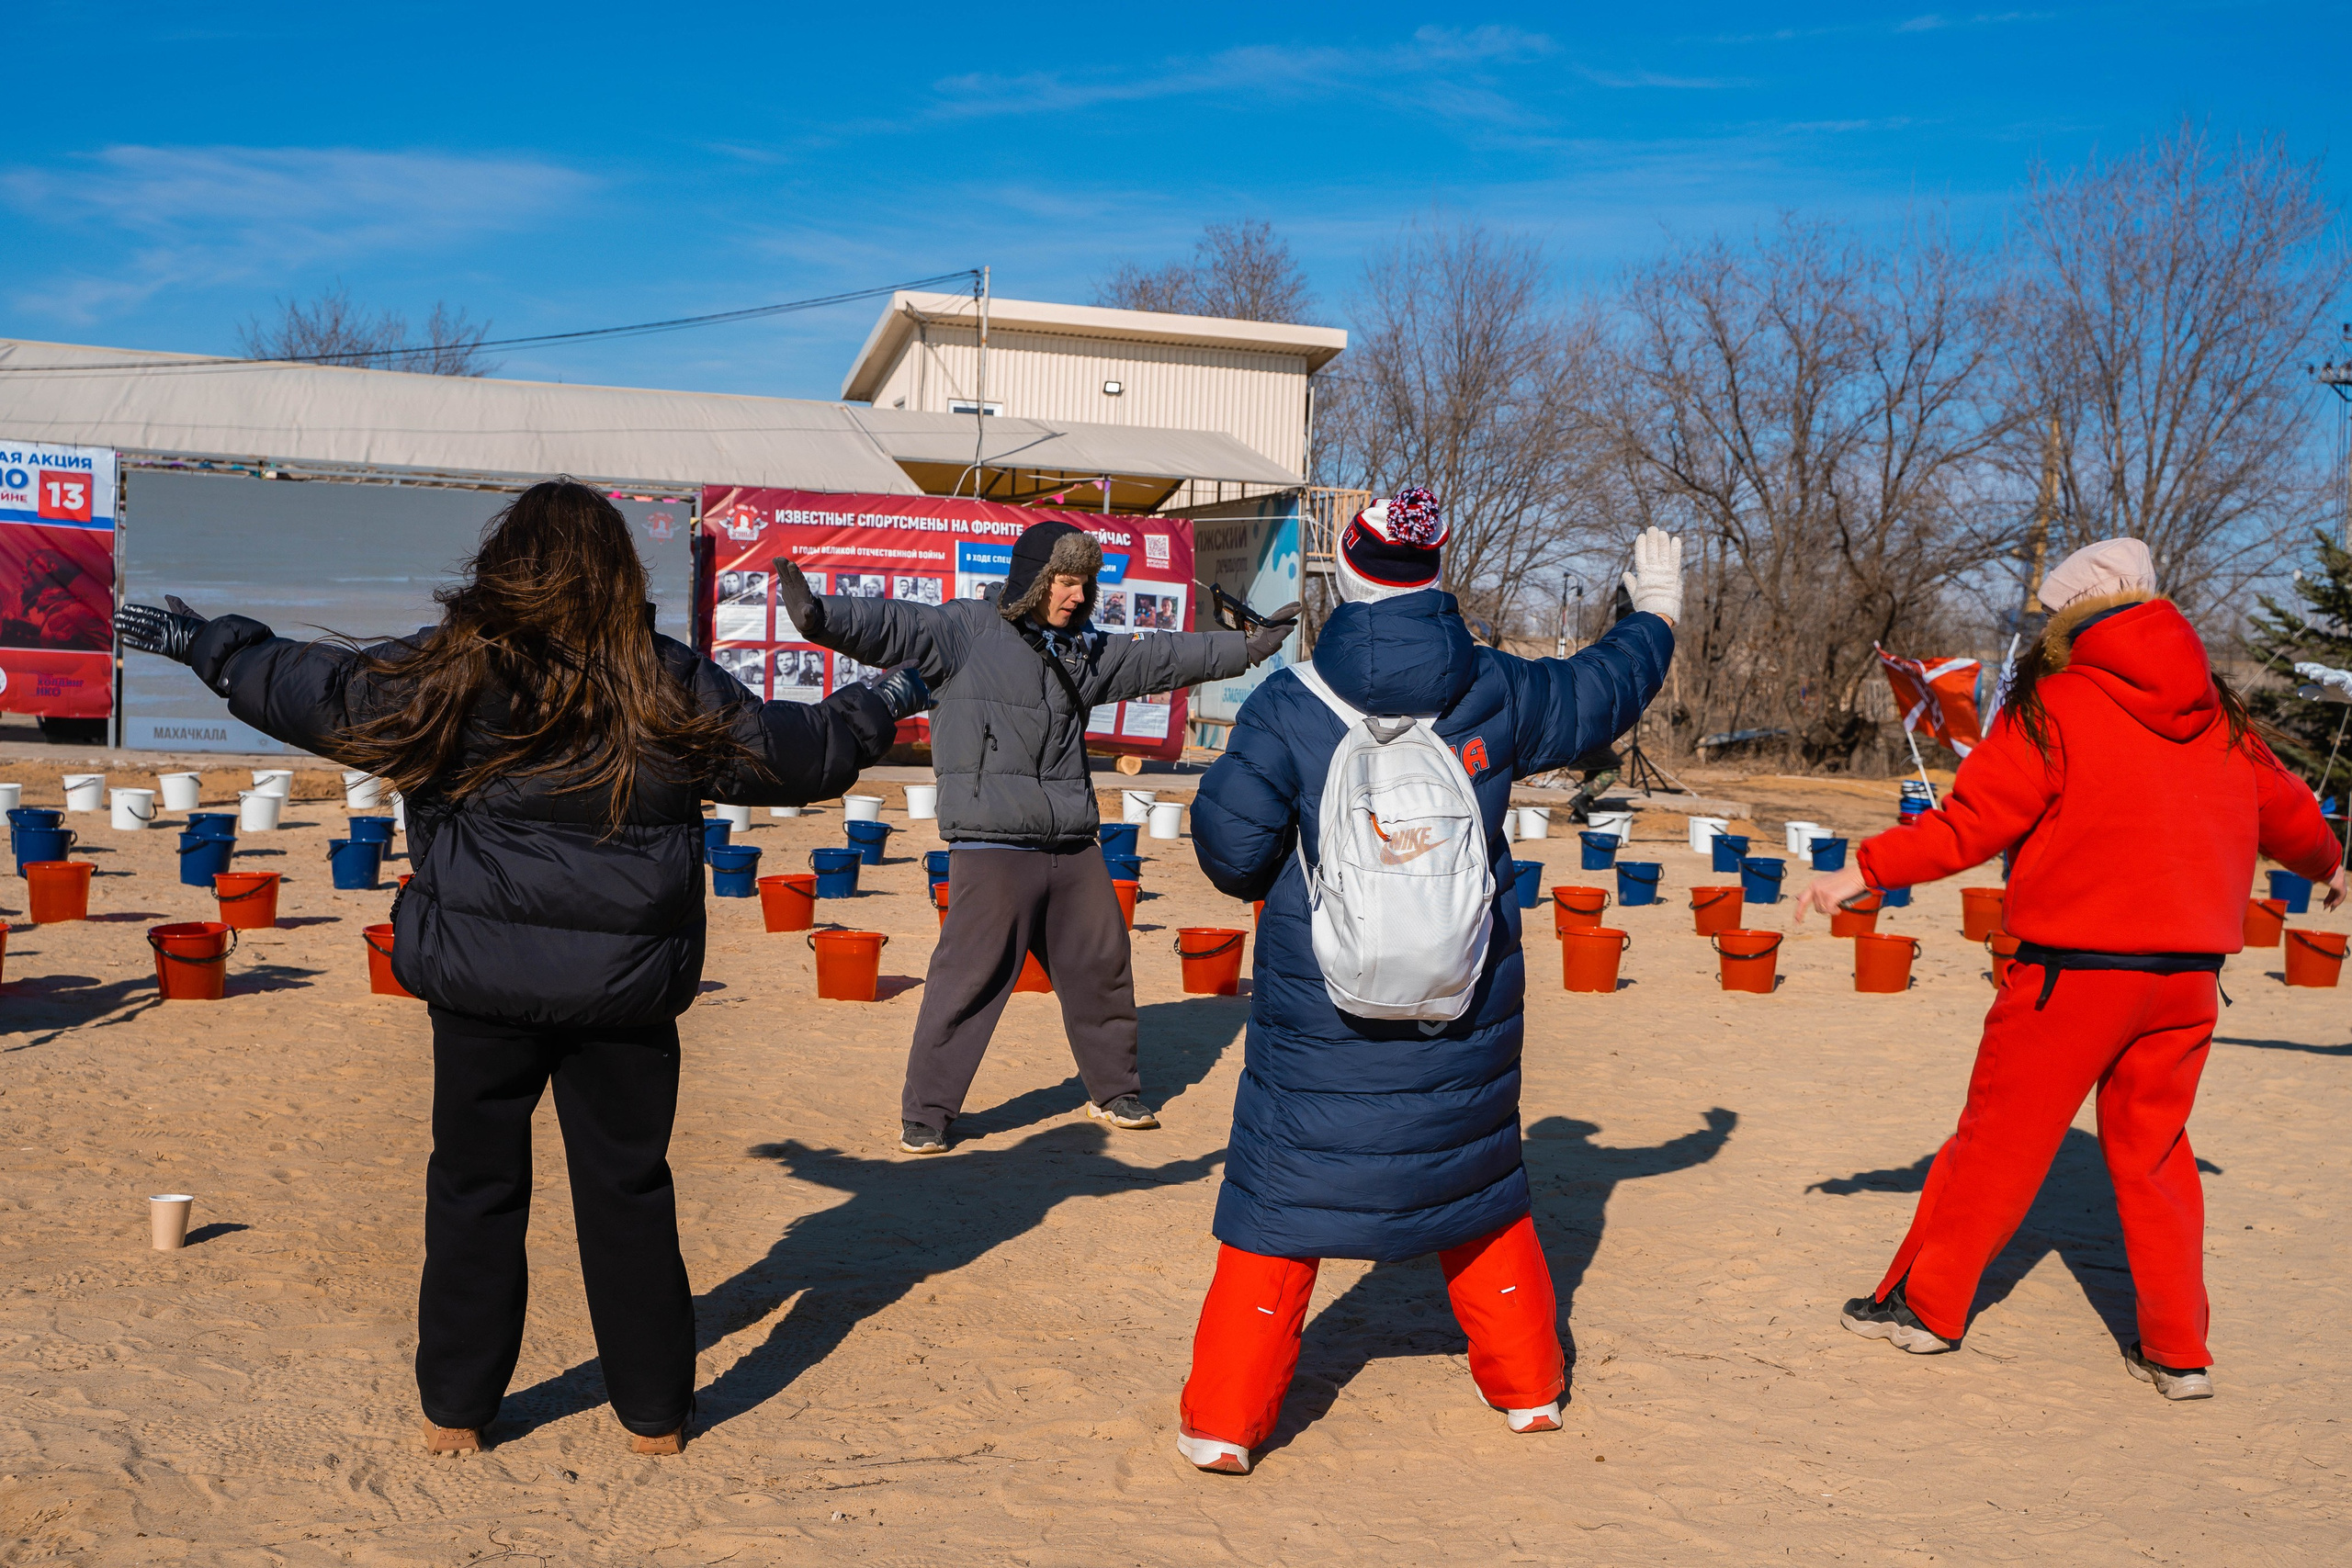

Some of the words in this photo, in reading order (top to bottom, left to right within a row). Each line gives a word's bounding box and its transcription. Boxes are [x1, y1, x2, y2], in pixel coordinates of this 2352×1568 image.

[28, 453, 92, 469] АКЦИЯ
[46, 481, 85, 511] 13
[775, 509, 855, 527] ИЗВЕСТНЫЕ
[857, 513, 948, 532] СПОРТСМЕНЫ
[951, 518, 969, 533] НА
[971, 519, 1023, 536] ФРОНТЕ
[792, 546, 797, 554] В
[798, 546, 820, 555] ГОДЫ
[821, 545, 855, 556] ВЕЛИКОЙ
[857, 547, 917, 558] ОТЕЧЕСТВЕННОЙ
[919, 549, 945, 559] ВОЙНЫ
[966, 553, 971, 561] В
[972, 554, 991, 563] ХОДЕ
[153, 727, 227, 741] МАХАЧКАЛА
[1389, 827, 1432, 851] NIKE
